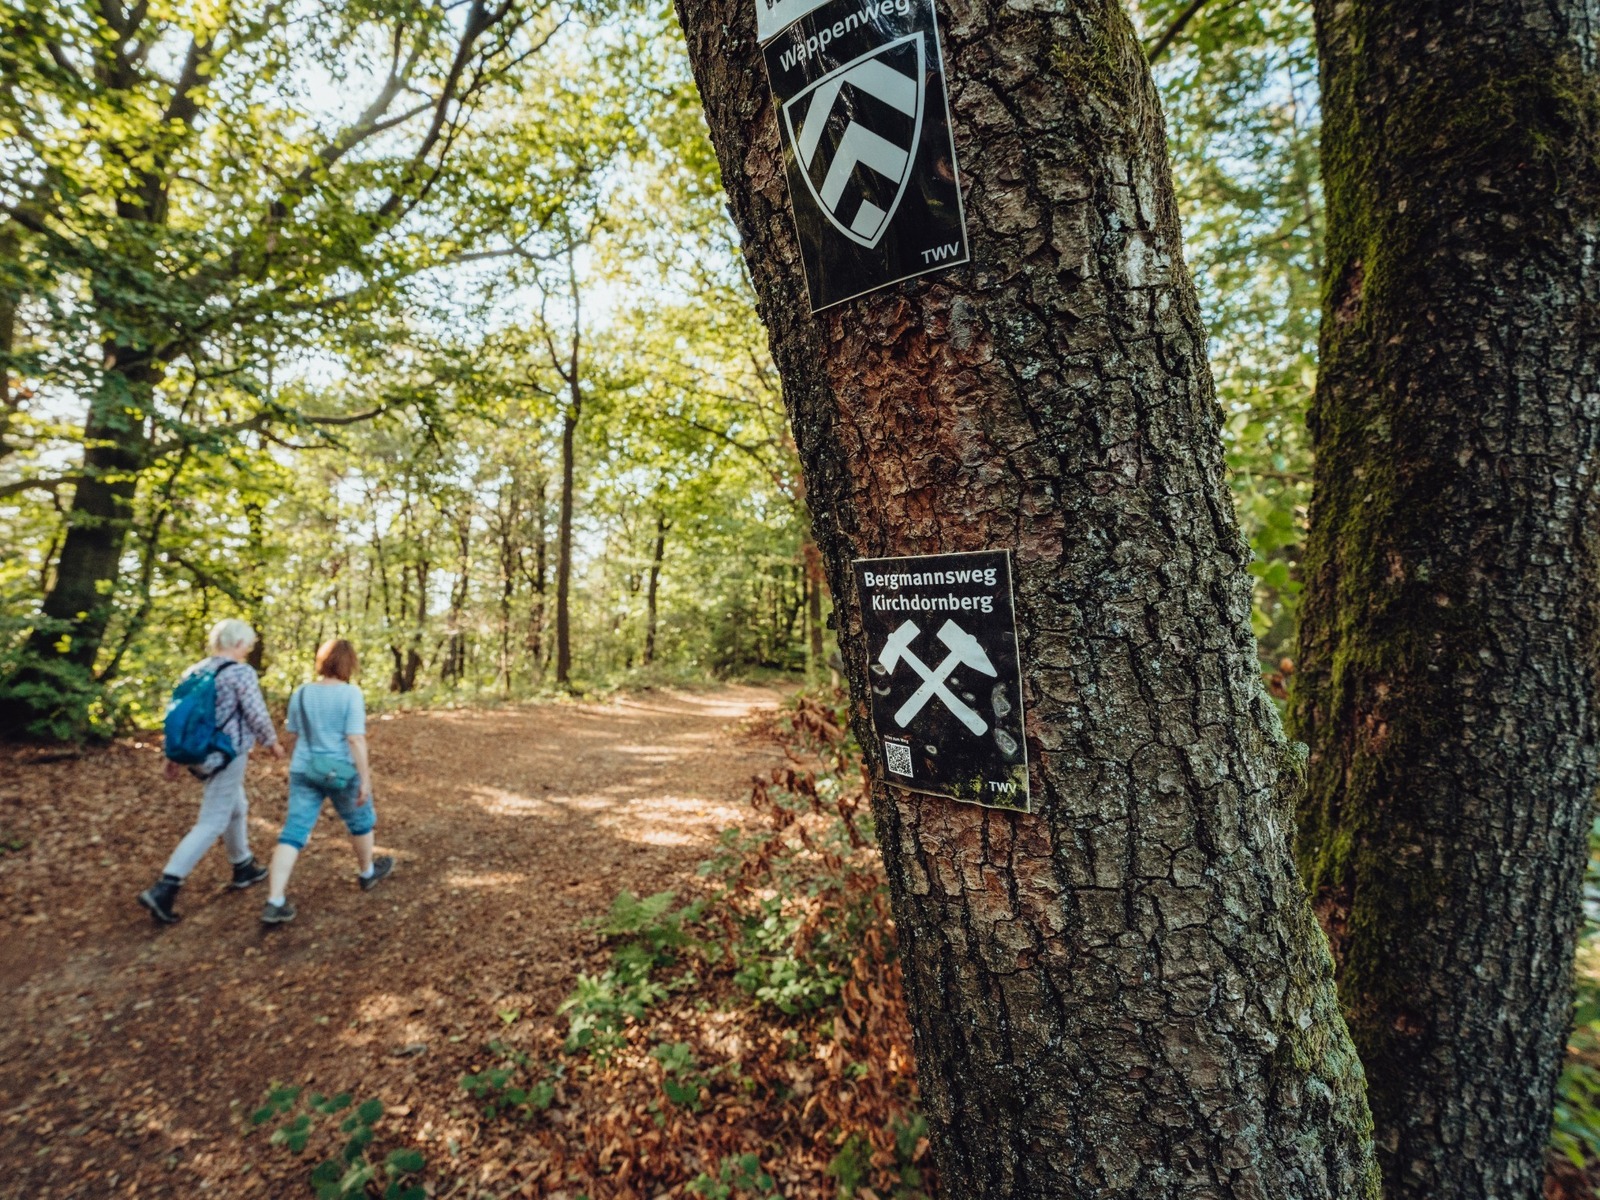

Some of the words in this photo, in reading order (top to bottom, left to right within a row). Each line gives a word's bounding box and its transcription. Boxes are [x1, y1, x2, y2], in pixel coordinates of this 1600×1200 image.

[779, 0, 910, 72] Wappenweg
[921, 241, 959, 264] TWV
[864, 567, 997, 589] Bergmannsweg
[872, 593, 994, 613] Kirchdornberg
[988, 781, 1017, 793] TWV
